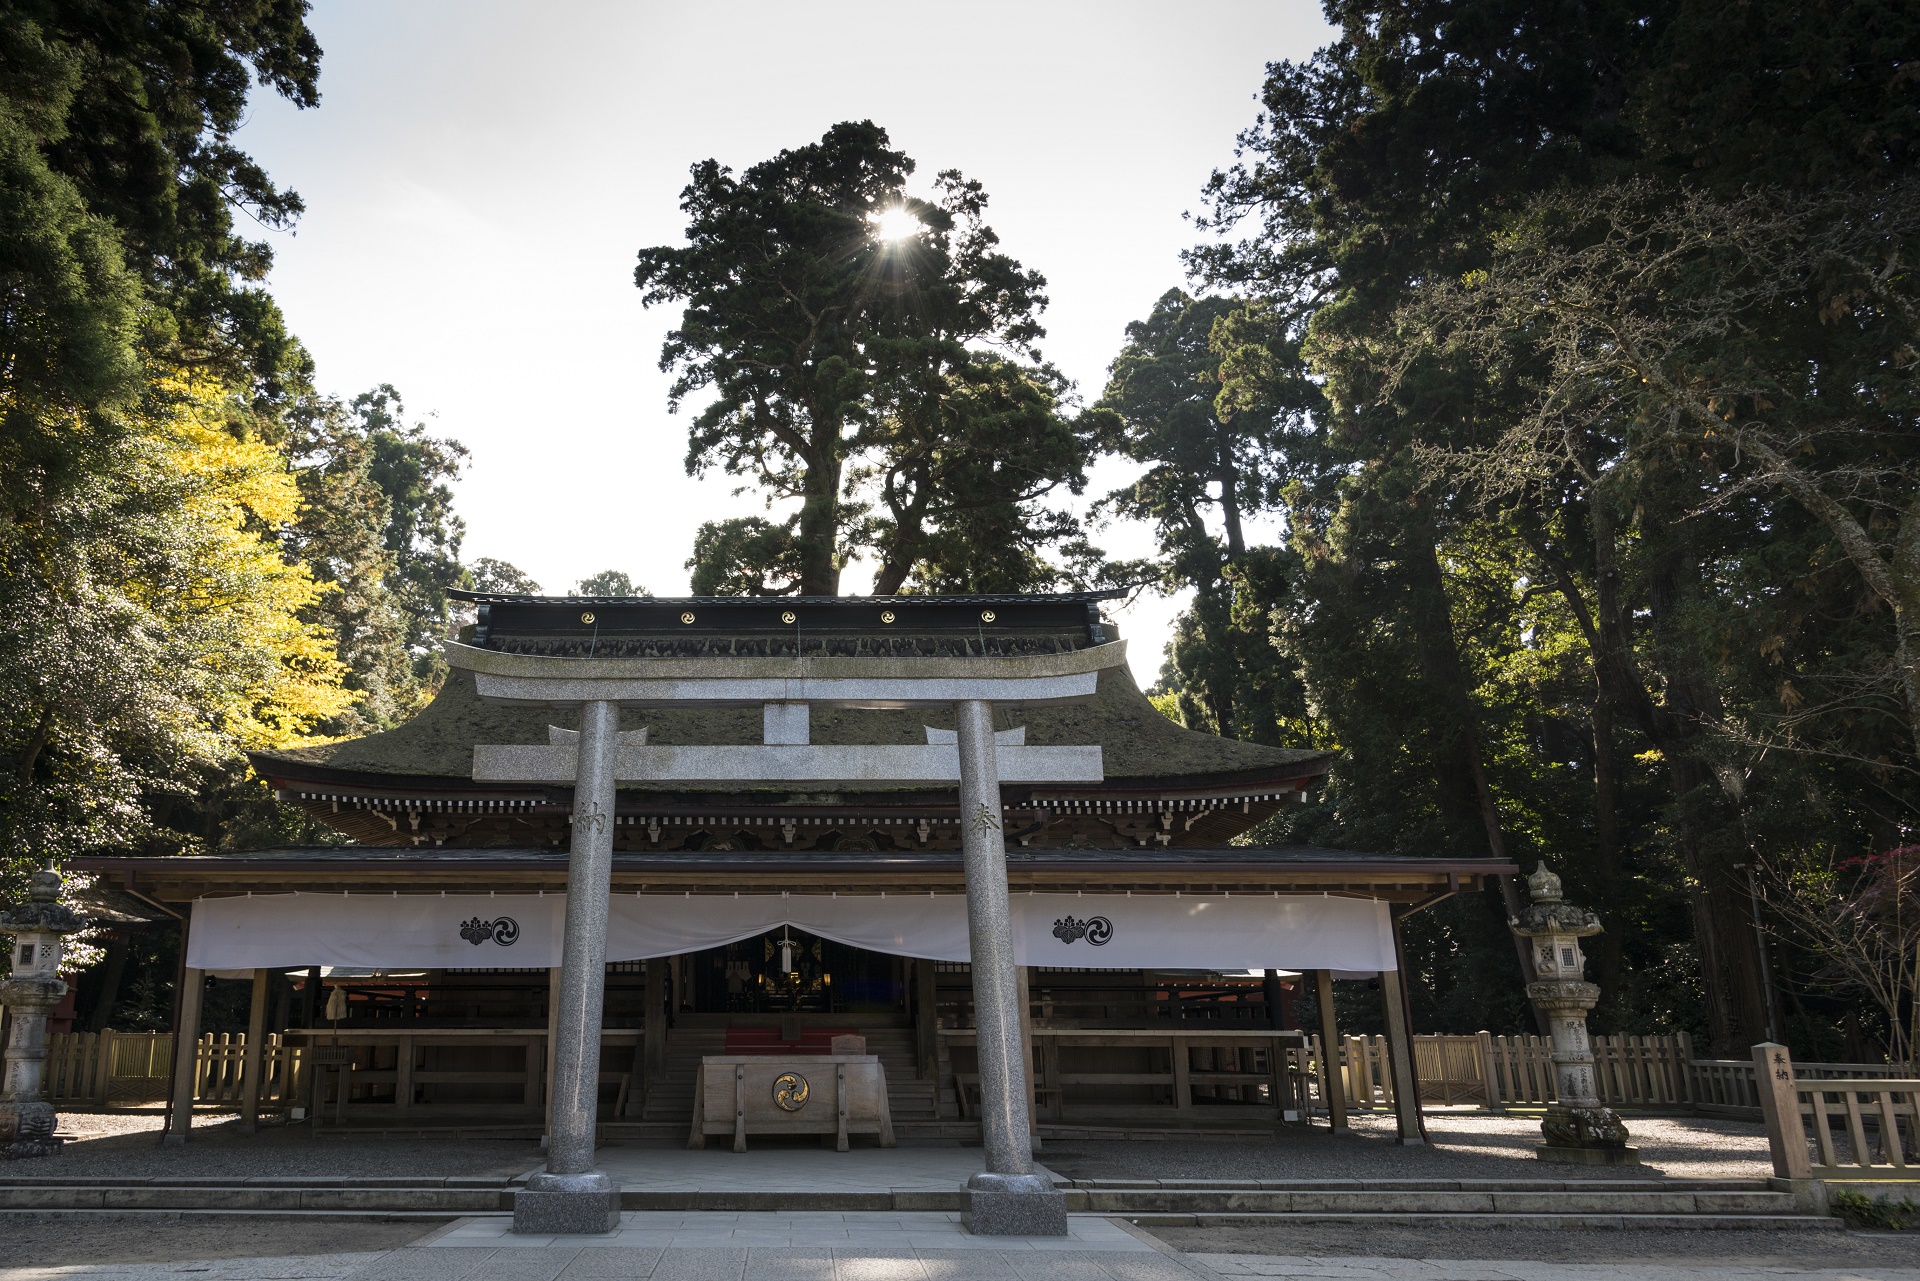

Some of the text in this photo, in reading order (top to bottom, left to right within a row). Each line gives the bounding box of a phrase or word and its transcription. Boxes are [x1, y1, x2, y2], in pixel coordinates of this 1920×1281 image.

[576, 801, 606, 835] 納
[970, 802, 1000, 838] 奉
[1772, 1052, 1789, 1081] 奉納
